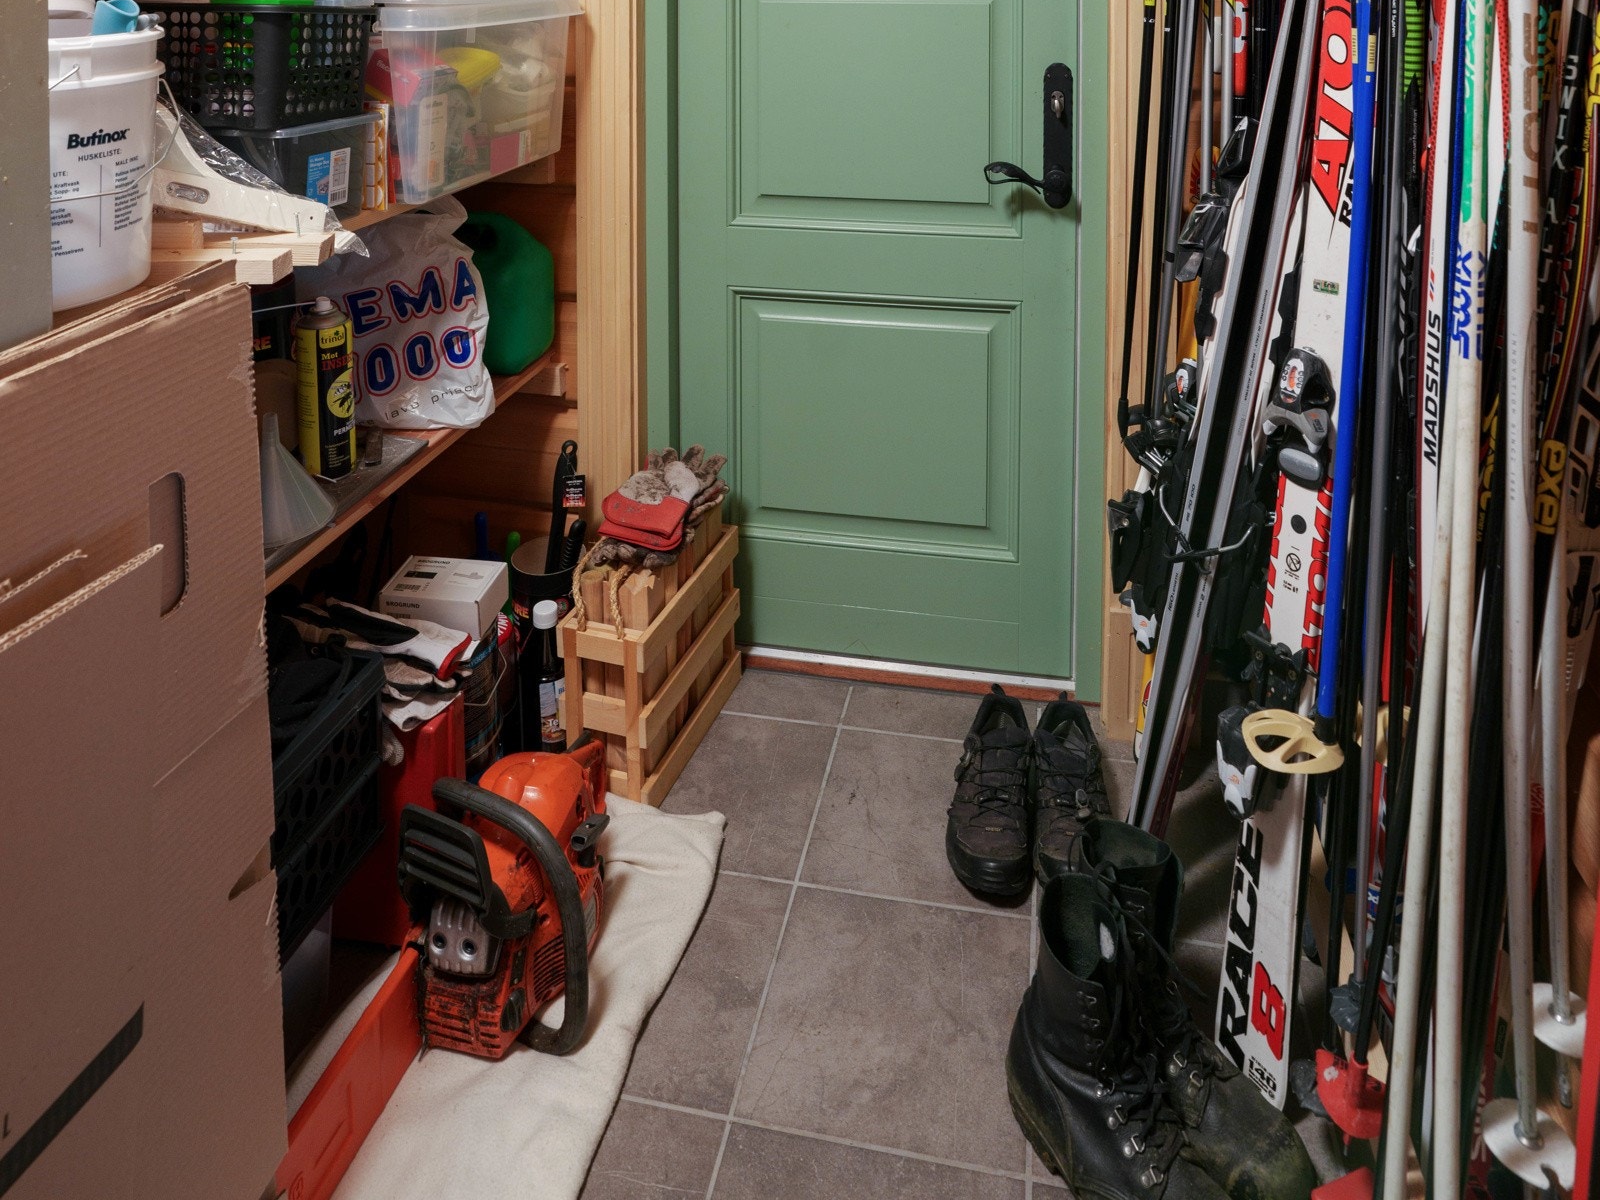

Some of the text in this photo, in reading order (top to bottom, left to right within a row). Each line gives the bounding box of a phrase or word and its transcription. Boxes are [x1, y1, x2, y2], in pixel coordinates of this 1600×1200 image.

[66, 128, 128, 150] Butinox
[78, 148, 123, 162] HUSKELISTE:
[336, 257, 478, 339] EMA
[319, 332, 345, 346] trinol
[320, 351, 339, 361] Mot
[1423, 310, 1441, 466] MADSHUS
[1534, 439, 1568, 536] exel
[385, 600, 420, 609] BROGRUND
[1218, 817, 1263, 1071] RACE
[1250, 960, 1286, 1061] 8
[1248, 1058, 1277, 1093] 140
